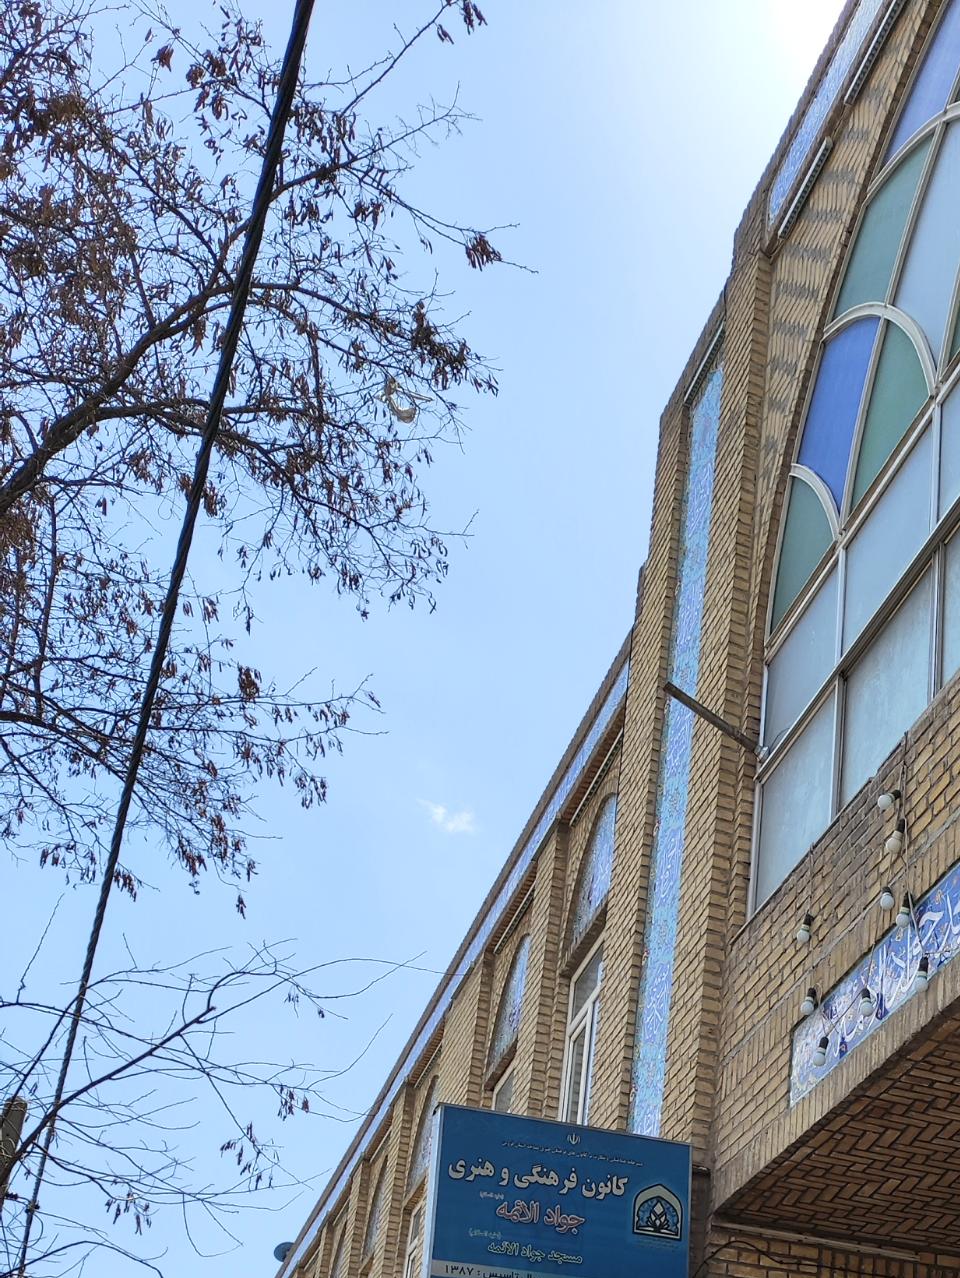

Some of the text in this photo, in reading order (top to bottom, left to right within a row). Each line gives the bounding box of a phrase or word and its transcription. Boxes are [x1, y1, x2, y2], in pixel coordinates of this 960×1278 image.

[448, 1157, 629, 1200] کانون فرهنگی و هنری
[544, 1204, 585, 1235] جواد
[521, 1244, 545, 1262] جواد
[548, 1250, 583, 1264] مسجد
[445, 1264, 475, 1276] ۱۳۸۷
